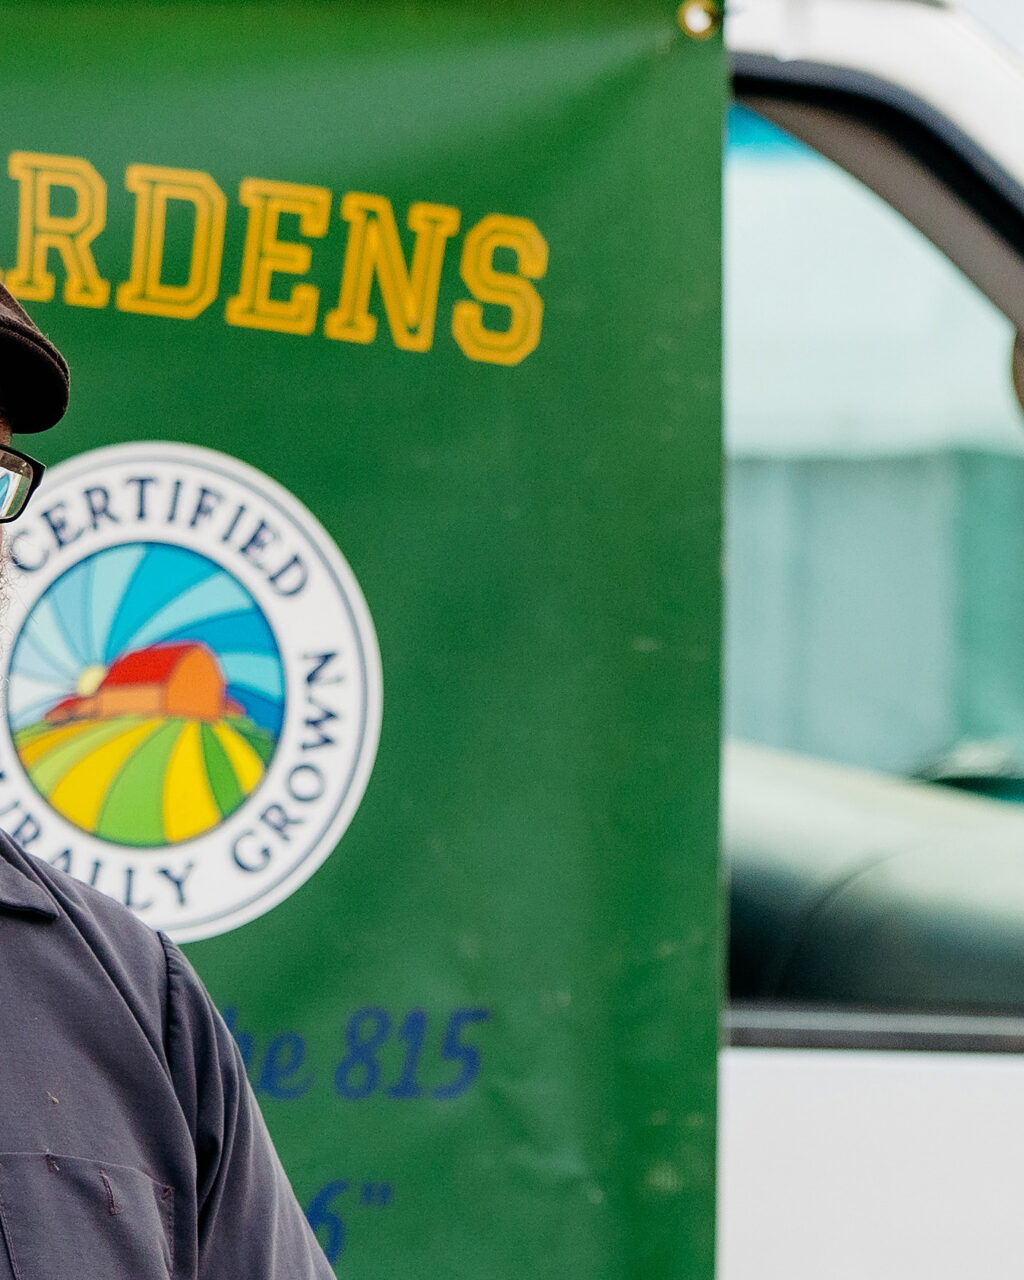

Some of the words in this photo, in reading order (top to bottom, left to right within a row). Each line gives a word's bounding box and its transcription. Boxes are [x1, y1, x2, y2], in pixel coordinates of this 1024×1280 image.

[9, 476, 309, 600] CERTIFIED
[230, 647, 344, 876] GROWN
[333, 1006, 493, 1101] 815
